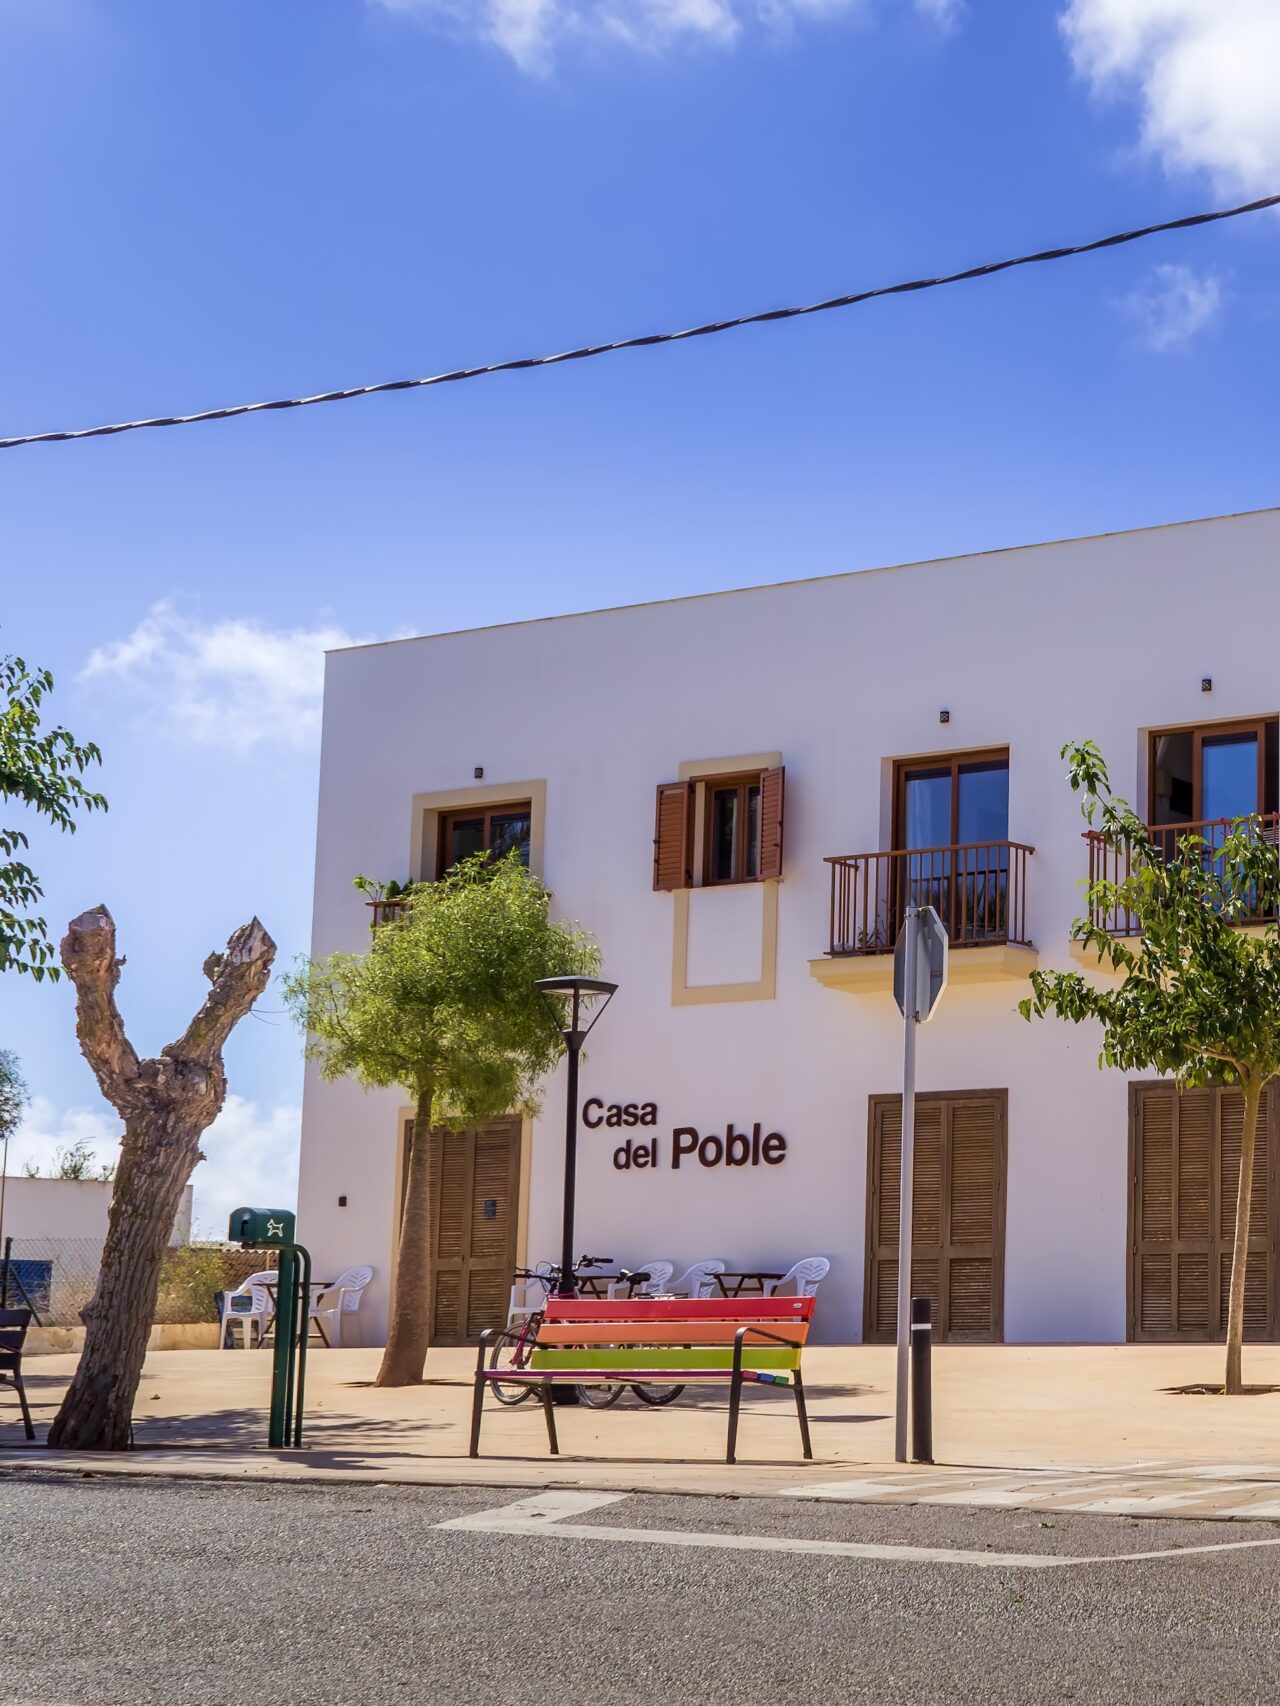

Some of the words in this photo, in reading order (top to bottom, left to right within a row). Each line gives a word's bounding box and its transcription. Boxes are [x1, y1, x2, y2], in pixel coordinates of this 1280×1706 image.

[582, 1097, 658, 1129] Casa
[613, 1138, 657, 1170] del
[671, 1123, 787, 1170] Poble
